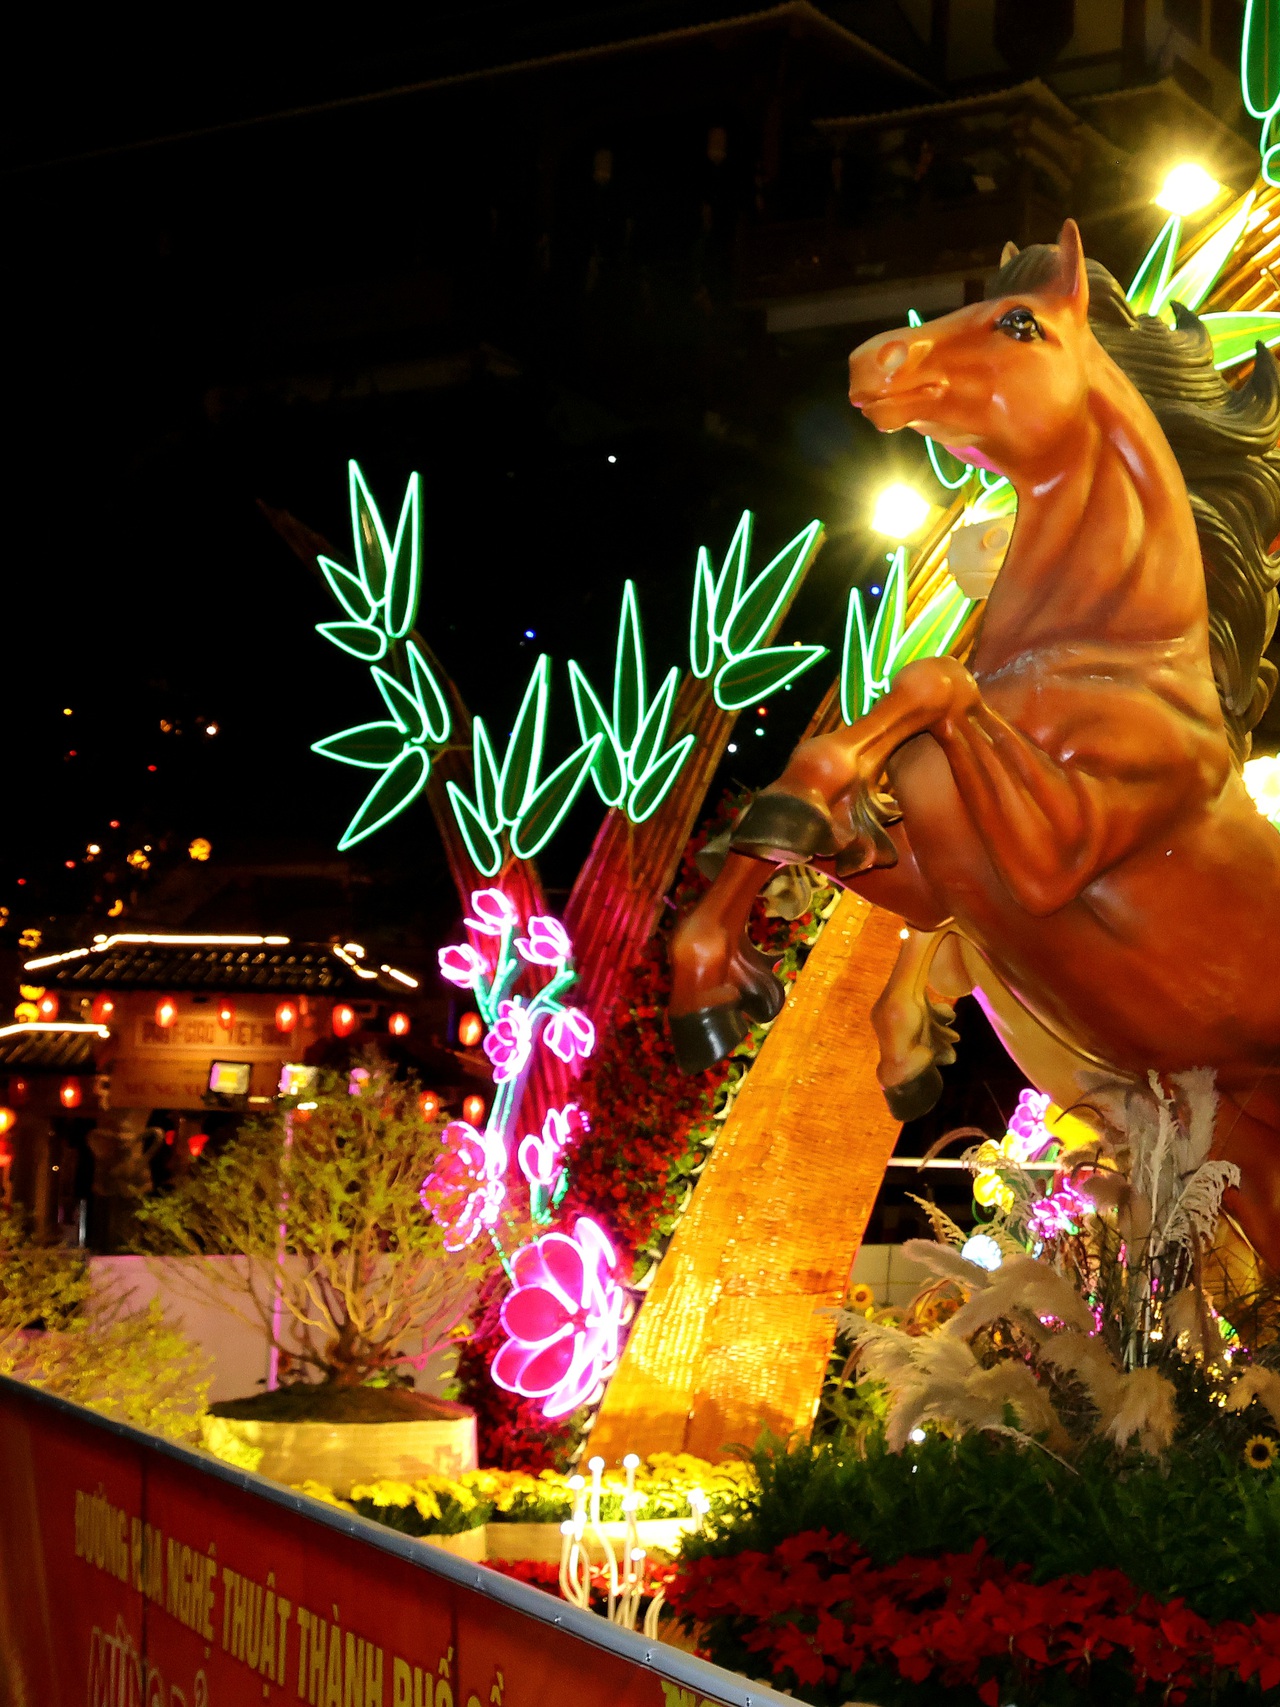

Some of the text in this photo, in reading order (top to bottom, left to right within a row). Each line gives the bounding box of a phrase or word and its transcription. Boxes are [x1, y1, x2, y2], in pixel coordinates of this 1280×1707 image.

[131, 1516, 163, 1607] HOA
[166, 1537, 217, 1659] NGHỆ
[222, 1567, 291, 1698] THUẬT
[297, 1603, 384, 1707] THÀNH
